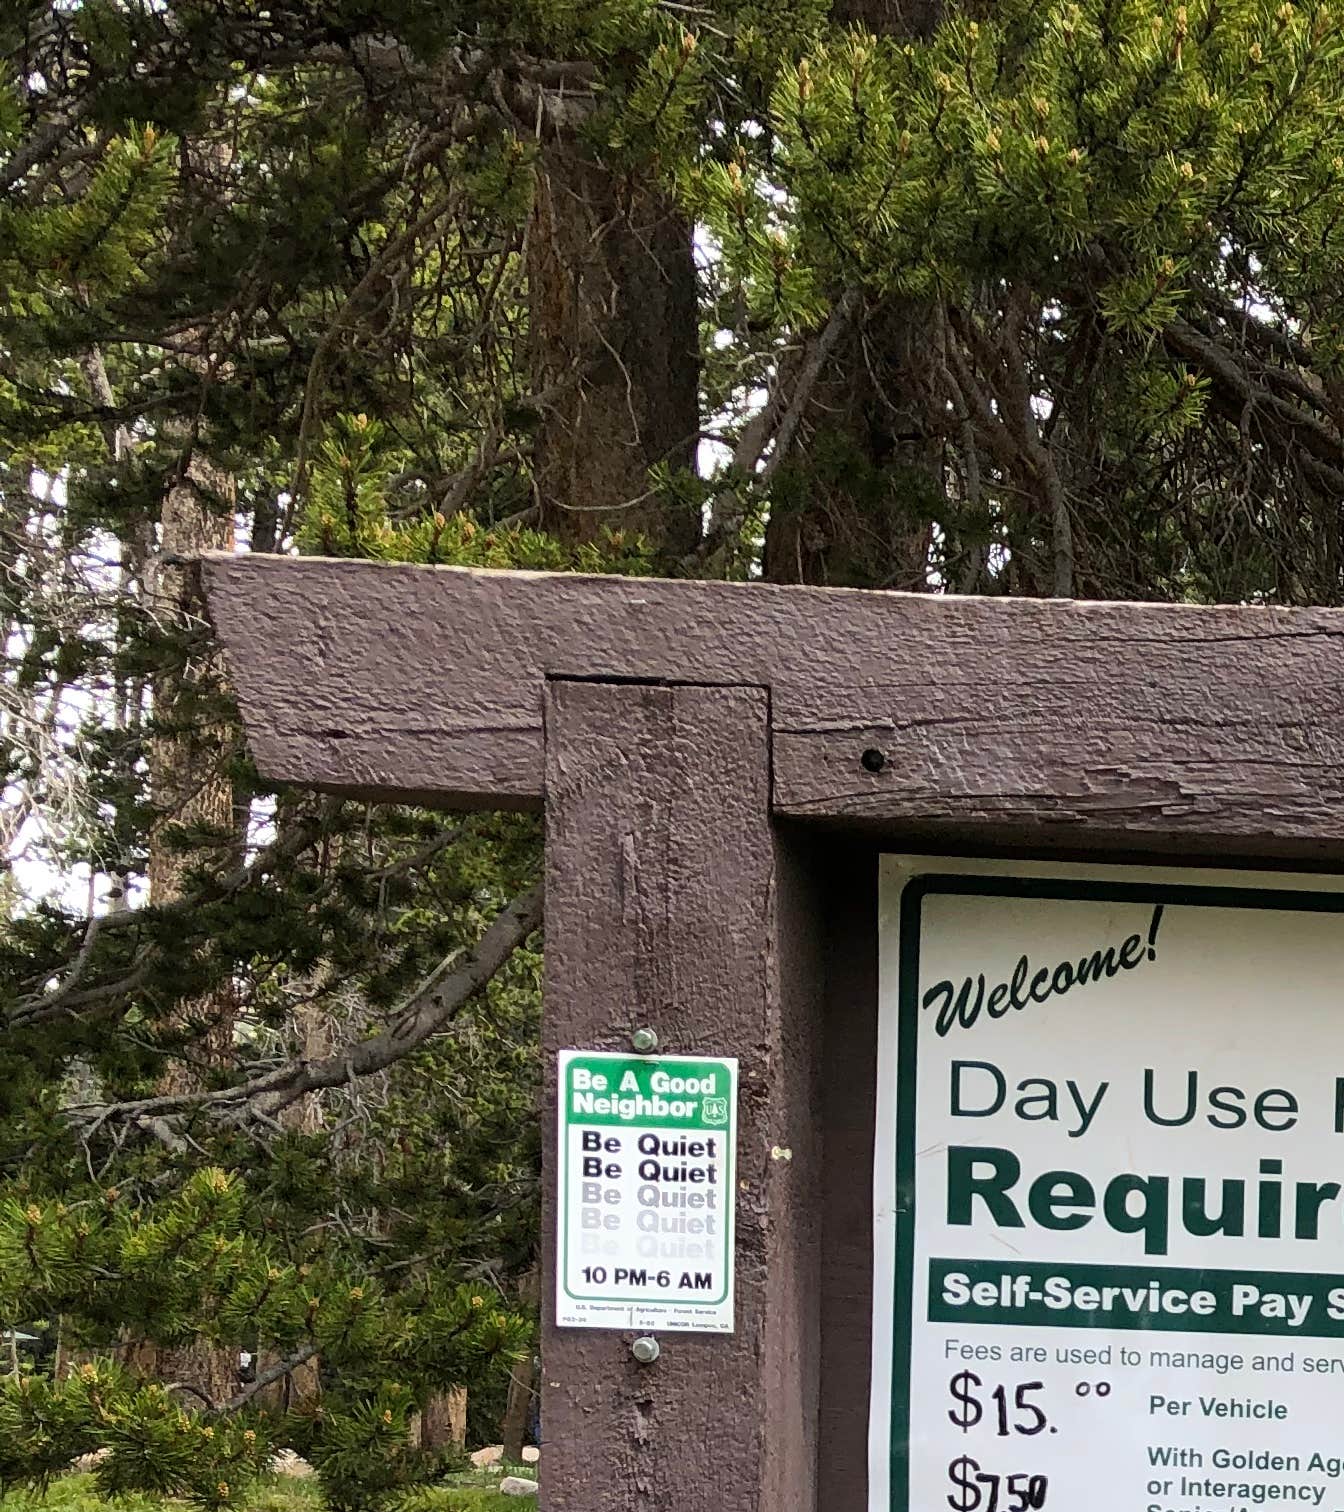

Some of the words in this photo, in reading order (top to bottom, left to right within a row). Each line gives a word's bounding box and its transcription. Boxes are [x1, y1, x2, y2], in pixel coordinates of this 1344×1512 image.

[923, 905, 1164, 1037] Welcome!
[573, 1069, 608, 1091] Be
[620, 1070, 639, 1092] A
[650, 1072, 716, 1094] Good
[573, 1092, 697, 1119] Neighbor
[950, 1060, 1109, 1137] Day
[1144, 1069, 1298, 1132] Use
[582, 1130, 622, 1152] Be
[638, 1134, 716, 1158] Quiet
[582, 1267, 606, 1283] 10
[615, 1268, 670, 1287] PM-6
[678, 1272, 712, 1289] AM
[942, 1273, 1216, 1316] Self-Service
[1232, 1284, 1313, 1326] Pay
[944, 1340, 1002, 1361] Fees
[1009, 1344, 1047, 1363] are
[1056, 1345, 1111, 1365] used
[1120, 1347, 1141, 1366] to
[1150, 1351, 1244, 1374] manage
[1252, 1353, 1294, 1373] and
[1150, 1395, 1192, 1417] Per
[1199, 1397, 1288, 1420] Vehicle
[1148, 1447, 1203, 1470] With
[1212, 1449, 1300, 1472] Golden
[1147, 1479, 1173, 1497] or
[1180, 1476, 1326, 1504] Interagency
